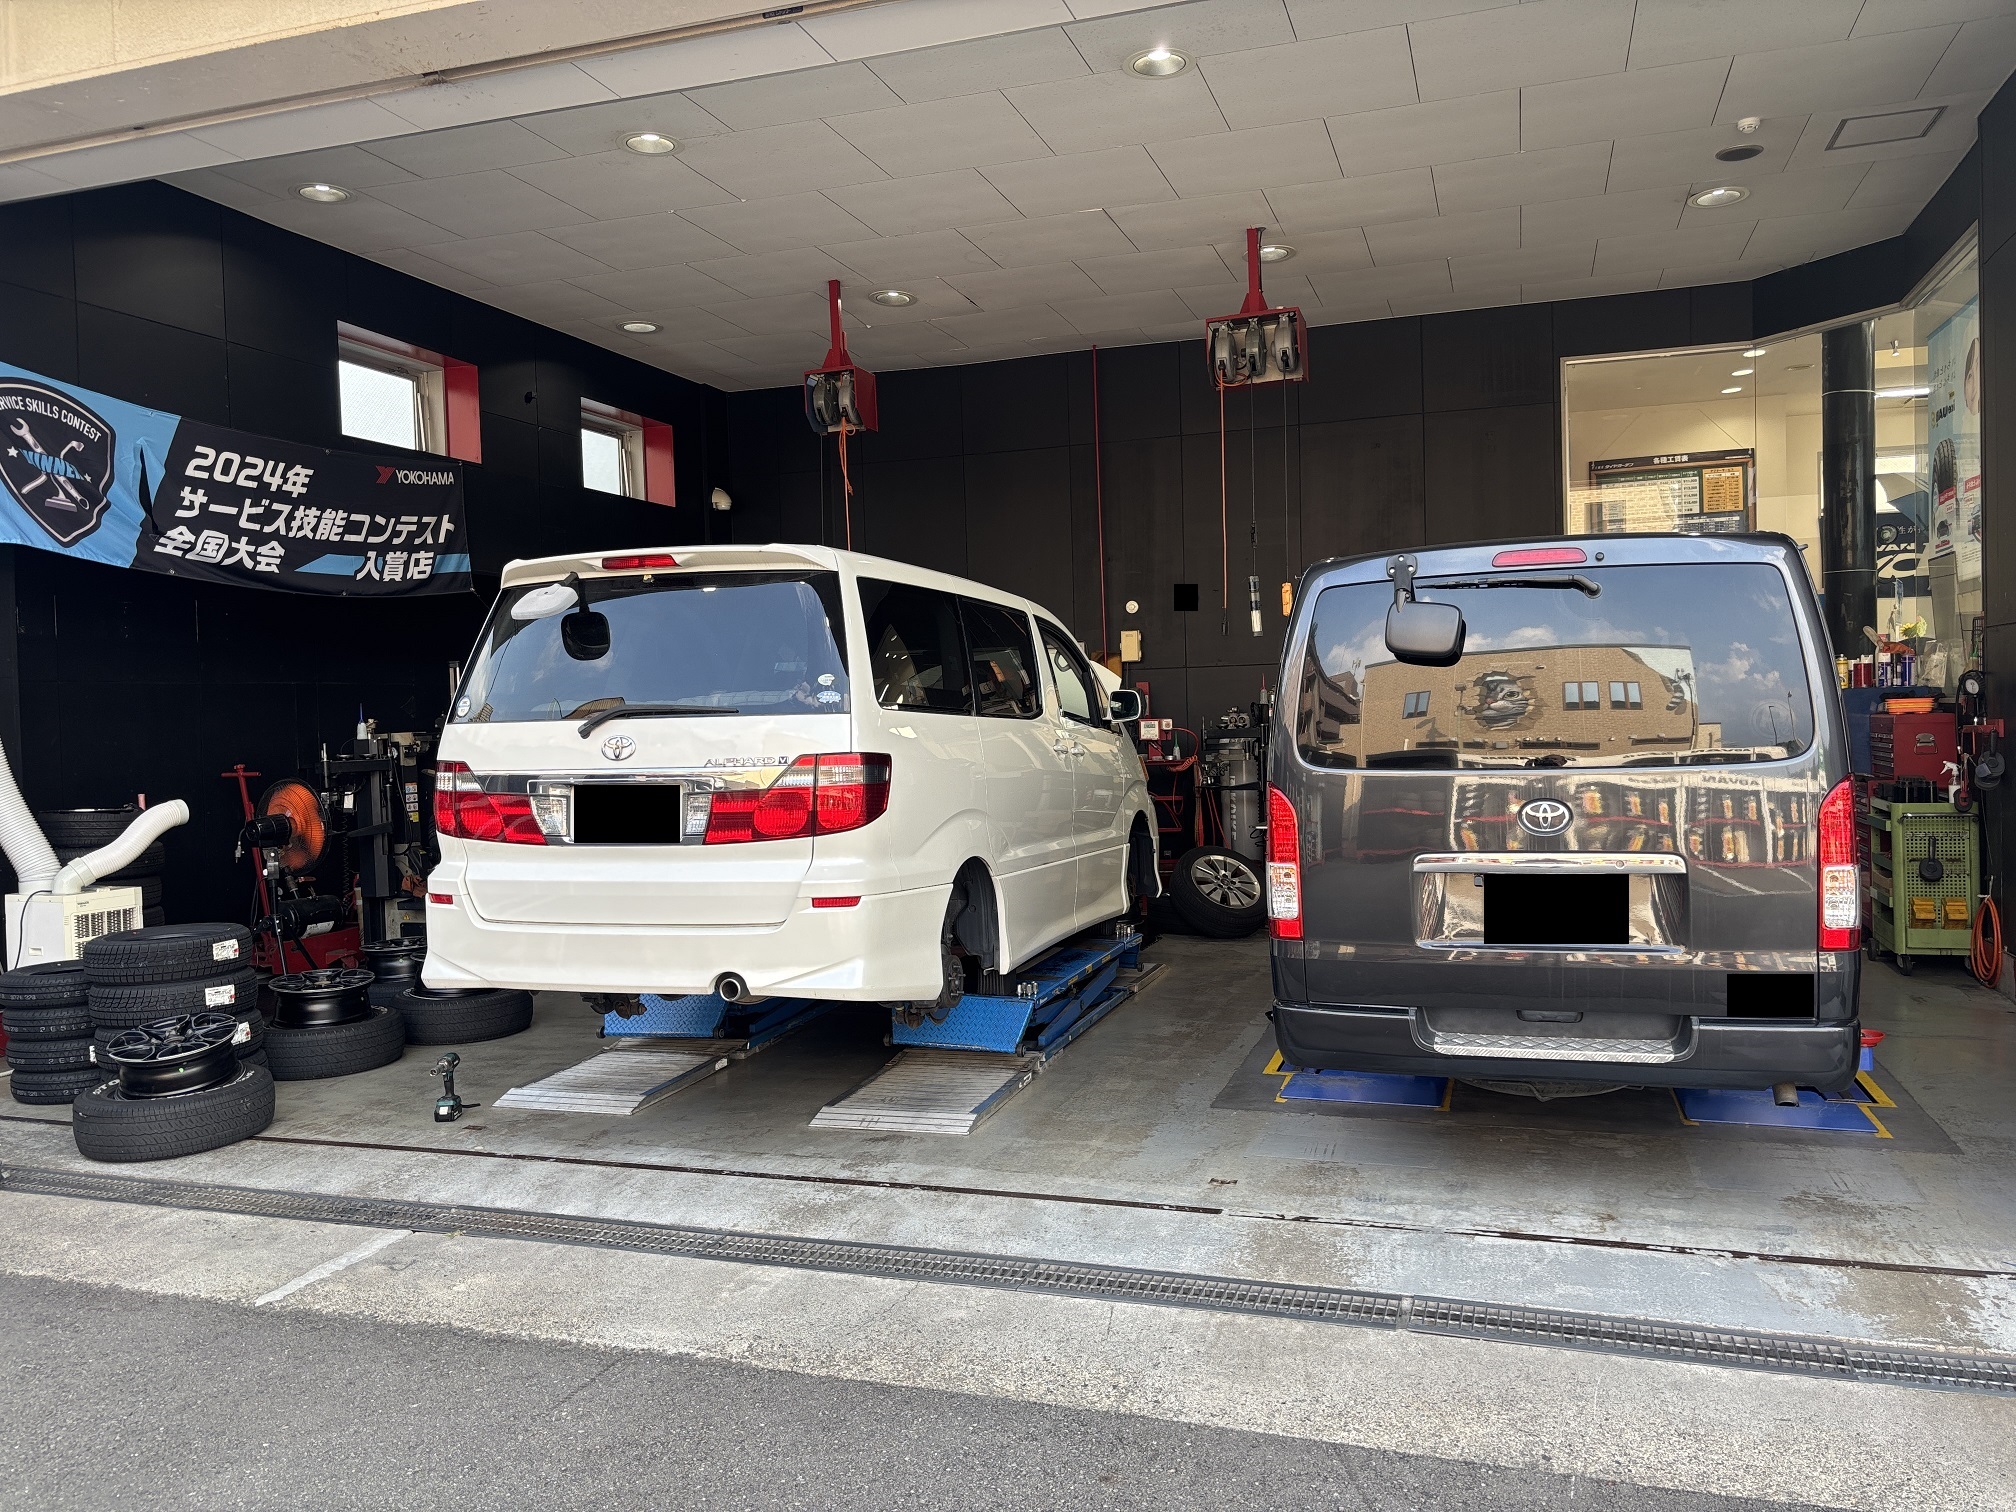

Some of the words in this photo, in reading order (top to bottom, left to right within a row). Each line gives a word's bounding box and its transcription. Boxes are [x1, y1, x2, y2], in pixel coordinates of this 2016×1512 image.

[0, 395, 25, 410] RVICE
[25, 398, 59, 419] SKILLS
[61, 409, 102, 442] CONTEST
[184, 445, 315, 498] 2024年
[395, 468, 455, 485] YOKOHAMA
[174, 486, 456, 545] サービス技能コンテスト
[153, 525, 286, 574] 全国大会
[356, 550, 436, 582] 入賞店
[704, 757, 776, 767] ALPHARD
